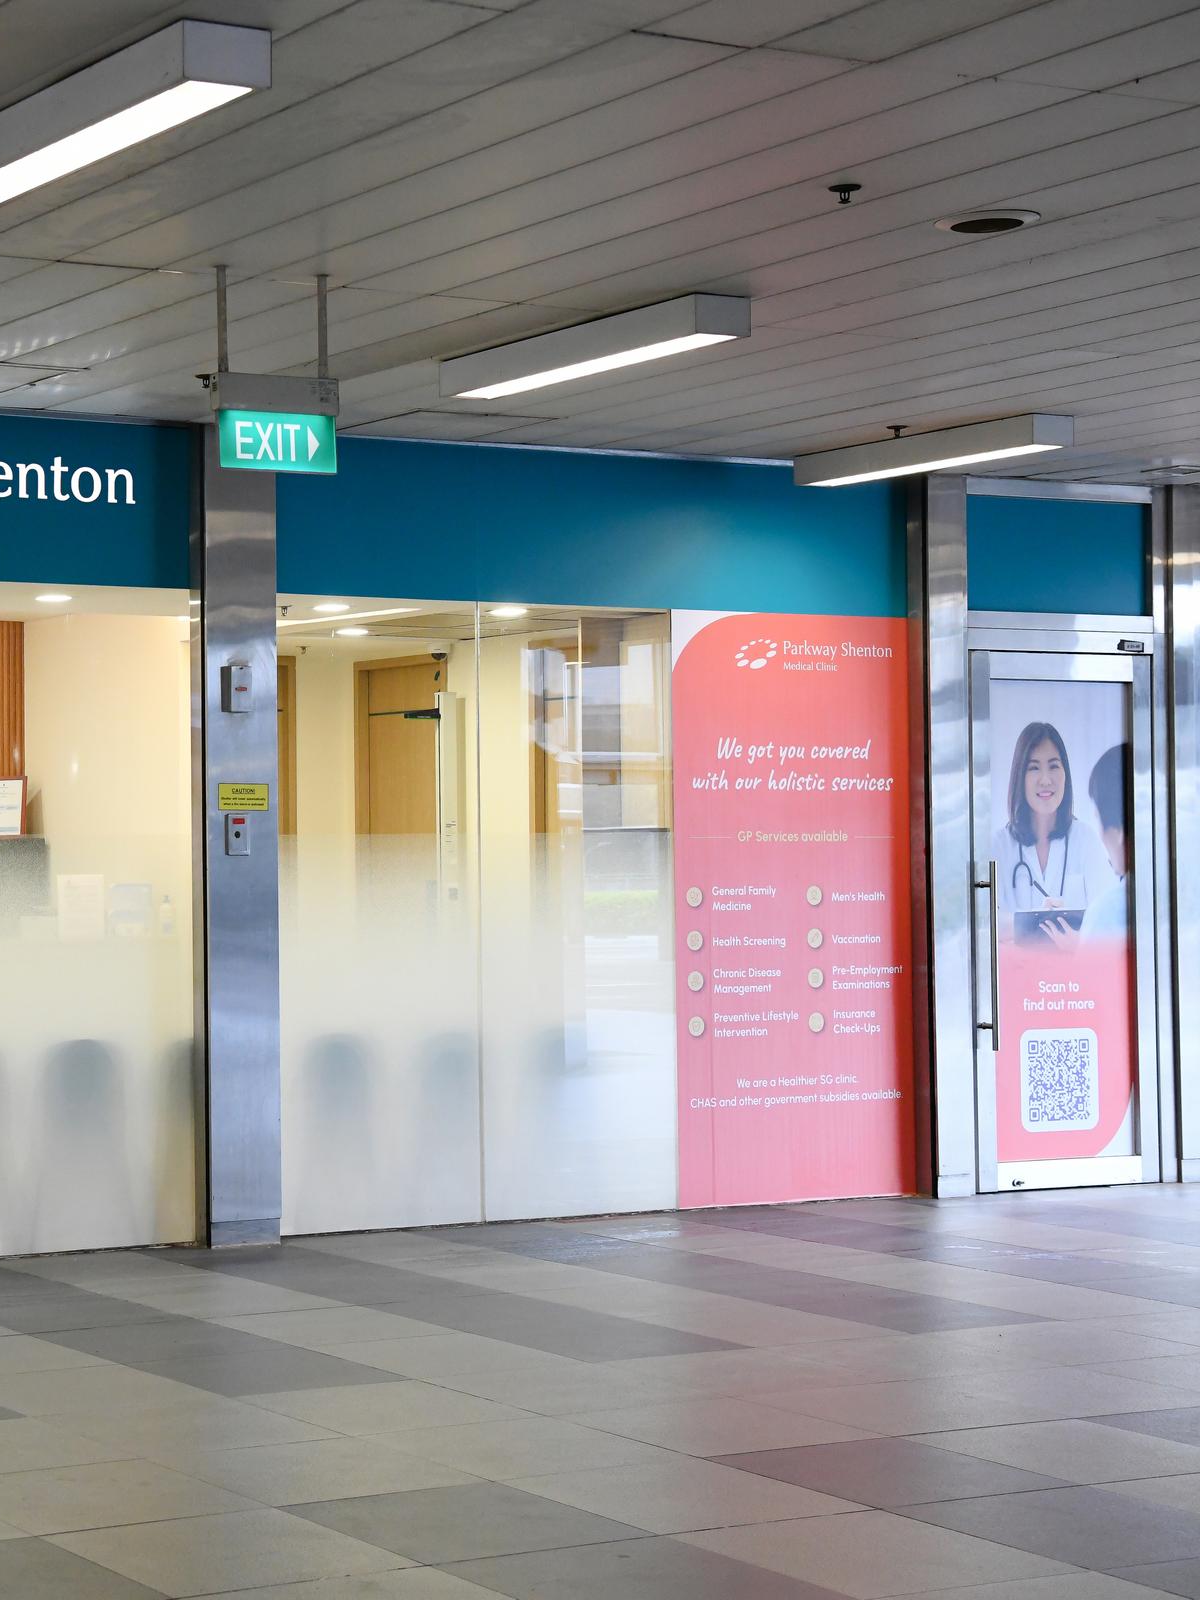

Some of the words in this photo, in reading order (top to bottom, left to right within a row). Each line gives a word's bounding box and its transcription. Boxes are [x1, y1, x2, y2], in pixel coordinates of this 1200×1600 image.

[235, 421, 300, 462] EXIT
[783, 640, 837, 660] Parkway
[841, 642, 893, 658] Shenton
[783, 662, 814, 671] Medical
[816, 662, 838, 672] Clinic
[717, 737, 742, 759] We
[748, 742, 774, 764] got
[780, 745, 804, 765] you
[811, 740, 871, 760] covered
[692, 770, 728, 790] with
[735, 777, 762, 790] our
[768, 770, 824, 791] holistic
[832, 775, 893, 792] services
[737, 831, 752, 842] GP
[756, 831, 798, 842] Services
[802, 830, 848, 842] available
[712, 886, 746, 896] General
[748, 886, 776, 898] Family
[832, 893, 856, 902] Men's
[857, 892, 885, 901] Health
[712, 902, 752, 911] Medicine
[713, 937, 741, 946] Health
[744, 937, 786, 948] Screening
[832, 935, 881, 944] Vaccination
[713, 968, 746, 978] Chronic
[749, 968, 781, 977] Disease
[832, 964, 903, 977] Pre-Employment
[714, 984, 772, 996] Management
[832, 980, 890, 990] Examinations
[1038, 981, 1066, 992] Scan
[1069, 981, 1080, 992] to
[1023, 998, 1044, 1010] find
[1047, 999, 1065, 1010] out
[1068, 1000, 1095, 1009] more
[714, 1012, 761, 1022] Preventive
[762, 1011, 799, 1022] Lifestyle
[833, 1009, 876, 1019] Insurance
[714, 1027, 768, 1037] Intervention
[833, 1024, 880, 1034] Check-Ups
[737, 1079, 750, 1088] We
[778, 1076, 816, 1087] Healthier
[820, 1075, 833, 1084] SG
[691, 1097, 717, 1108] CHAS
[720, 1096, 736, 1107] and
[740, 1096, 761, 1106] other
[764, 1094, 817, 1106] government
[820, 1091, 859, 1102] subsidies
